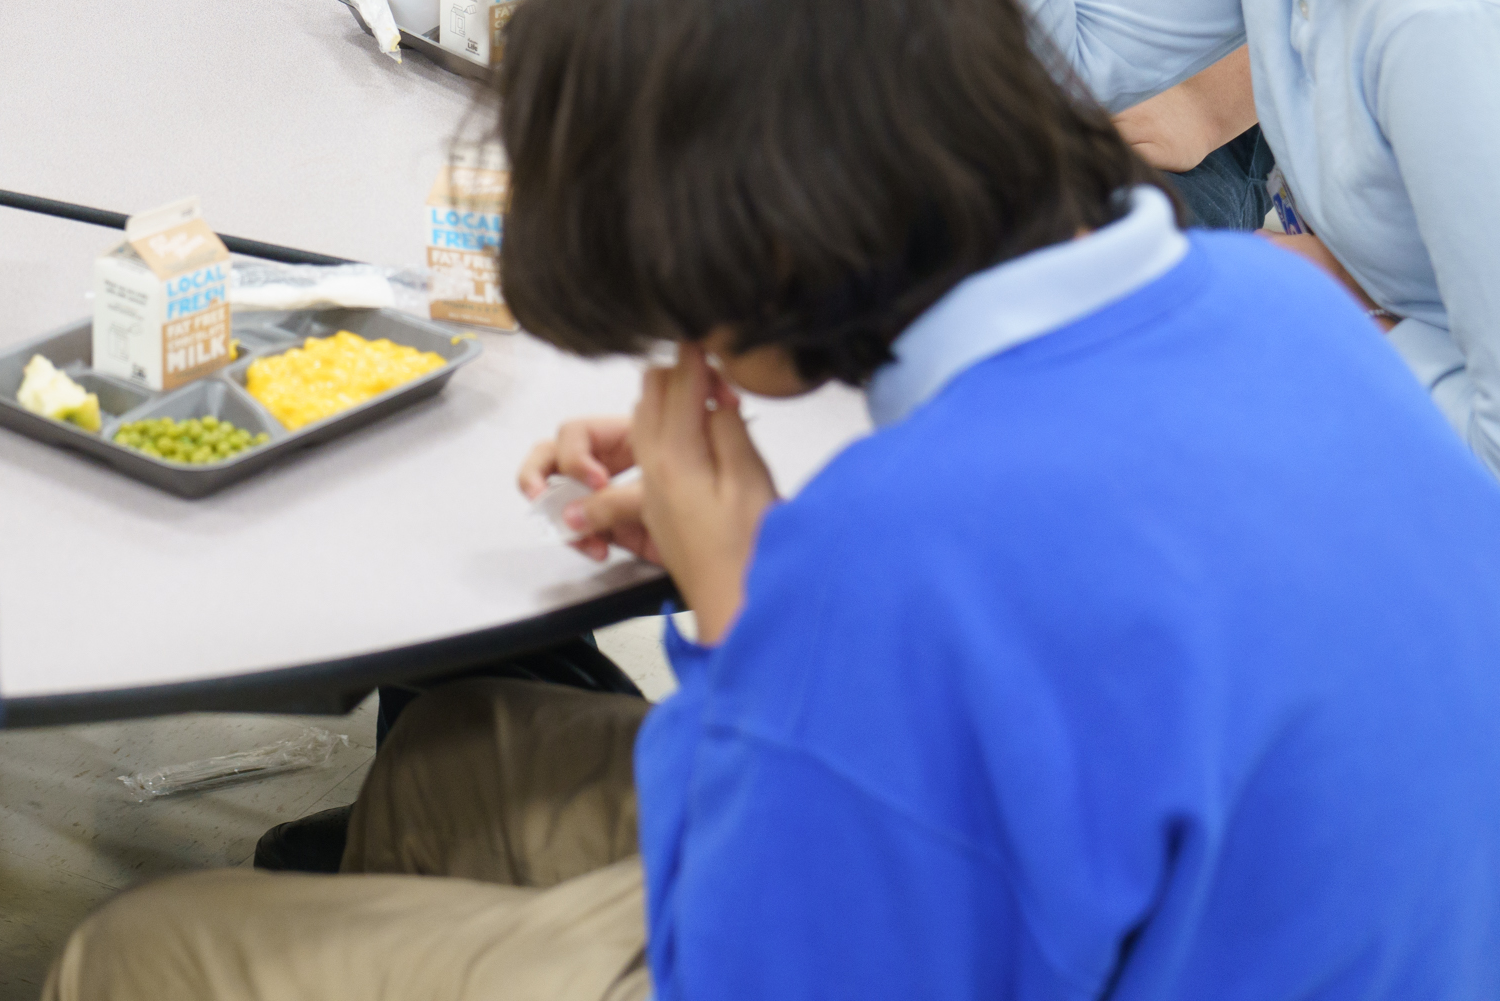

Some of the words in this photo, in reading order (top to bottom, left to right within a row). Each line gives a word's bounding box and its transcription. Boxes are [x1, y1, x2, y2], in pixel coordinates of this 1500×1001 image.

[432, 208, 503, 234] LOCAL
[166, 264, 227, 297] LOCAL
[167, 283, 225, 321] FRESH
[167, 334, 227, 374] MILK
